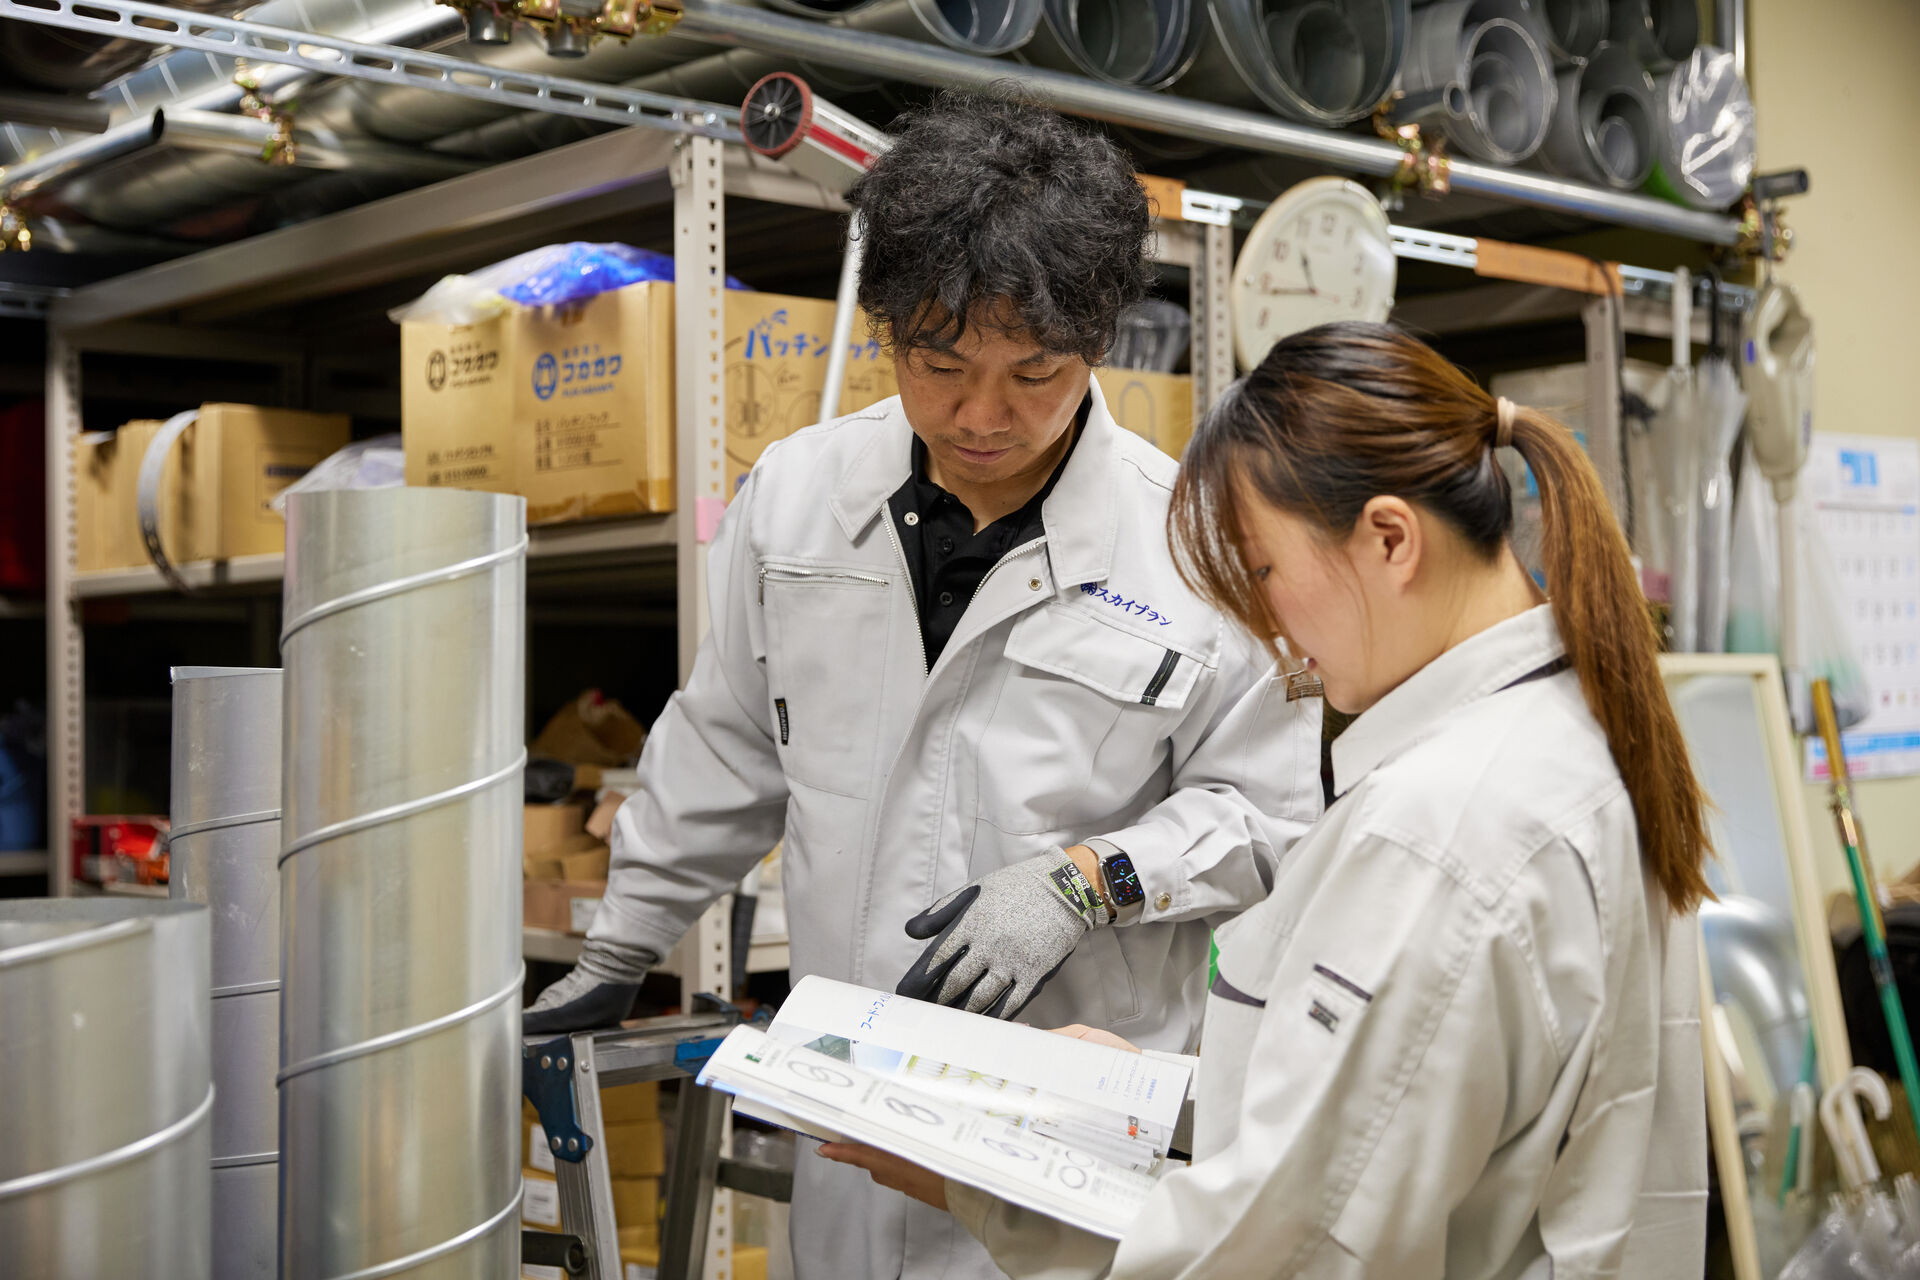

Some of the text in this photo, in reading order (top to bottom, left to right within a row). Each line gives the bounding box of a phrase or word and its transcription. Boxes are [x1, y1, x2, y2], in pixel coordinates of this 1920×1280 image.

[744, 309, 880, 361] パッチンック
